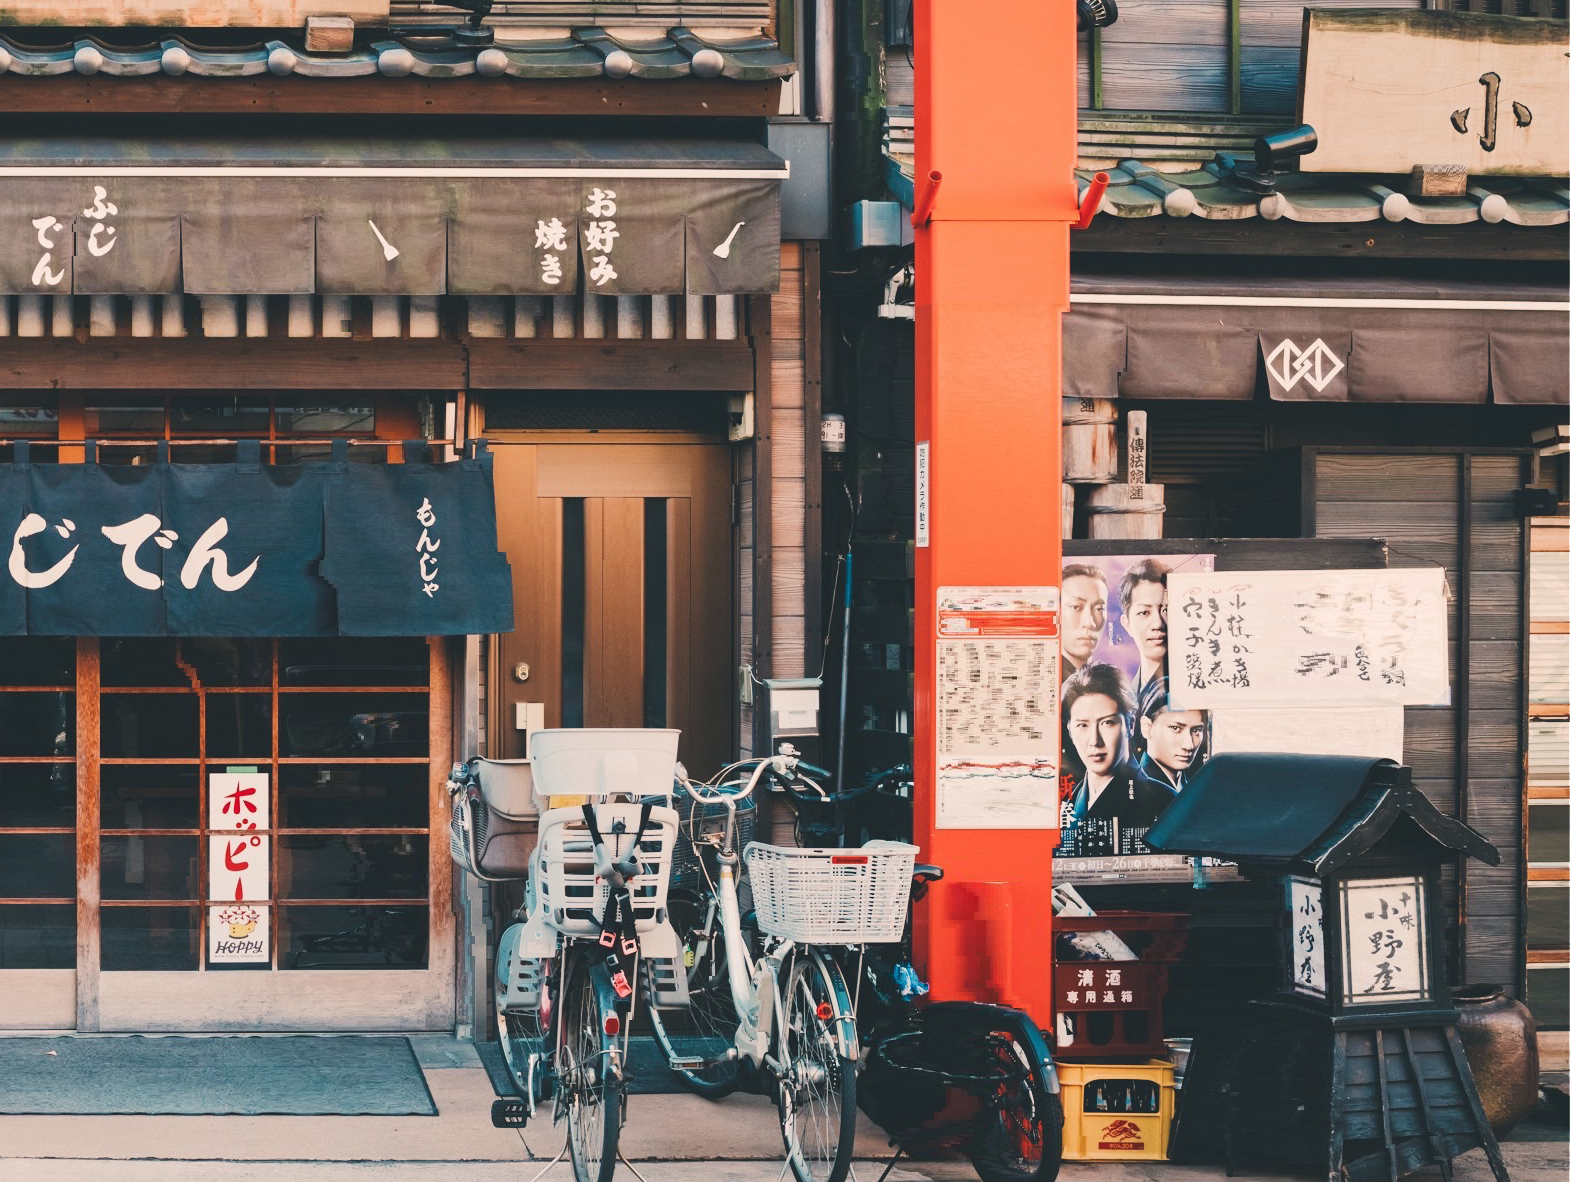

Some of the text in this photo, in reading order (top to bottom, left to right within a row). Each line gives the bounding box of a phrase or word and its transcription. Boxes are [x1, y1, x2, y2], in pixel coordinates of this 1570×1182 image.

[32, 215, 65, 286] でん
[83, 185, 118, 257] ふじ
[534, 217, 568, 285] 焼き
[584, 187, 620, 286] お好み
[1129, 437, 1145, 500] 傳法院通
[416, 497, 441, 598] もんじゃ
[222, 780, 261, 901] ホッピー
[214, 940, 264, 954] Hoppy
[1299, 895, 1316, 984] 小野屋
[1363, 898, 1403, 993] 小野屋
[1066, 990, 1133, 1004] 専用通箱
[1077, 969, 1122, 987] 清酒
